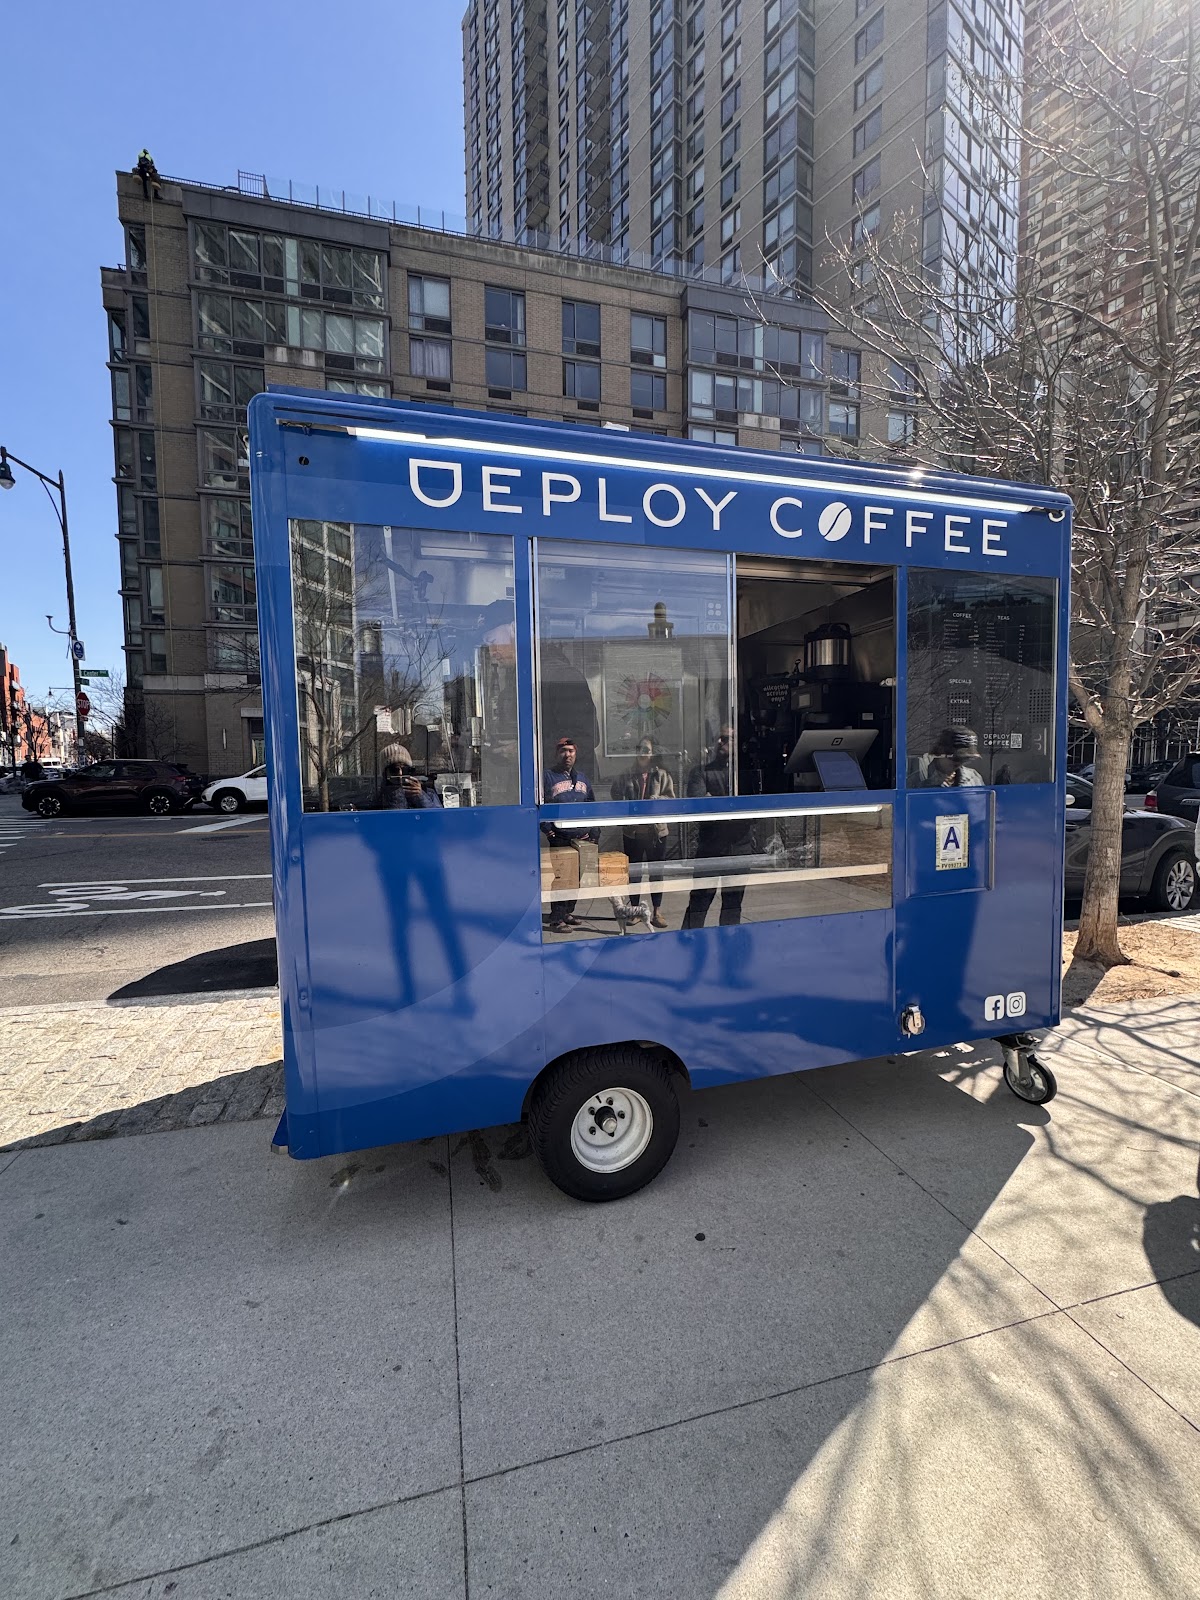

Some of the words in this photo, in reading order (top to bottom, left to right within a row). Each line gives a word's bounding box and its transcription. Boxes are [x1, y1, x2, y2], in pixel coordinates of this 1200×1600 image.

[408, 458, 738, 531] DEPLOY
[769, 497, 1008, 556] COFFEE
[77, 699, 90, 709] STOP
[942, 826, 960, 851] A
